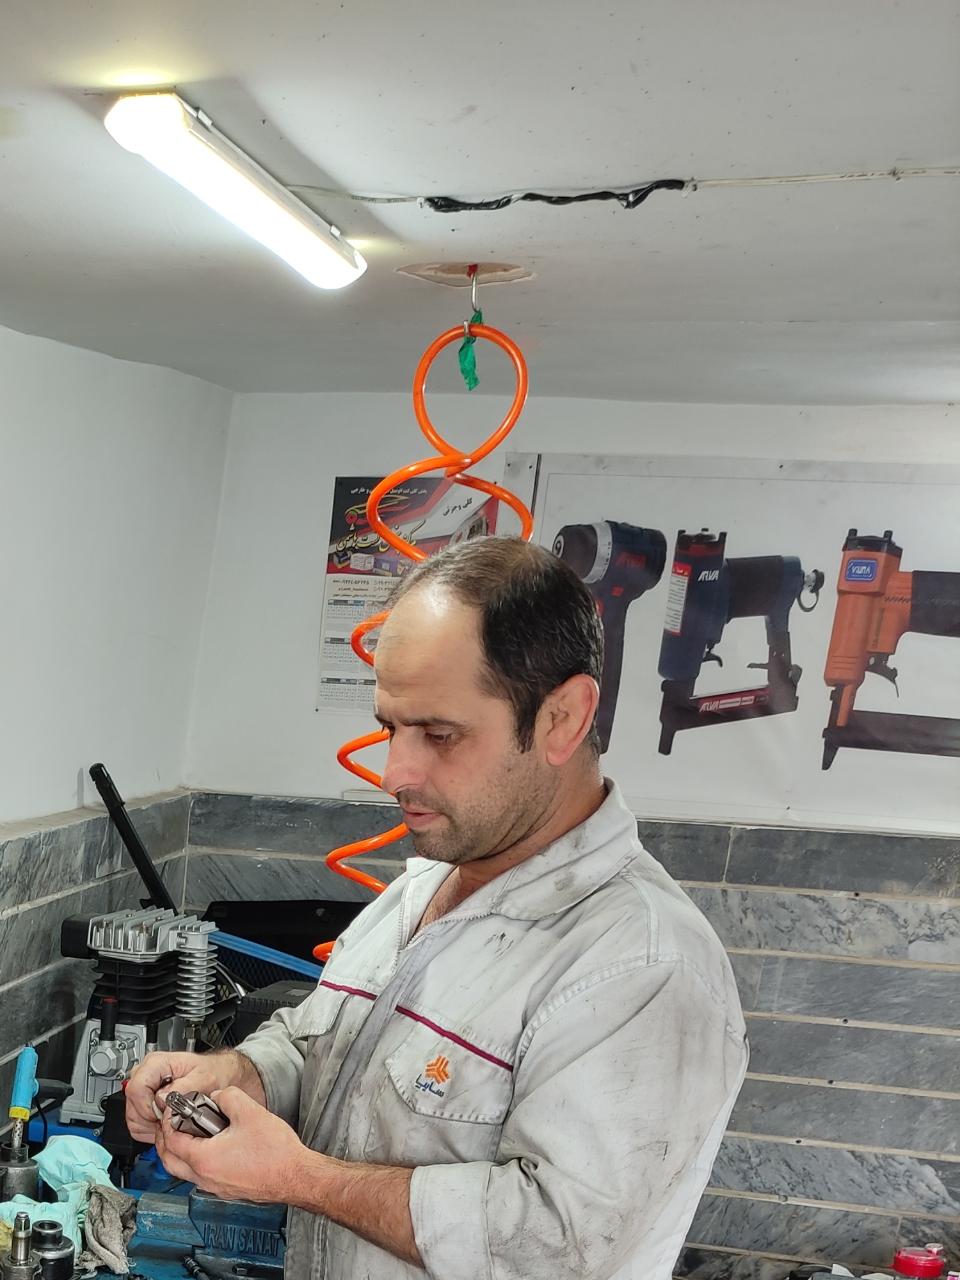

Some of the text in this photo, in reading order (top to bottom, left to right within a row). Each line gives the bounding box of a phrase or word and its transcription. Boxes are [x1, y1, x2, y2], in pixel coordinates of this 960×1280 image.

[414, 1073, 445, 1098] سایپا
[203, 1223, 281, 1257] IRAN SANAT
